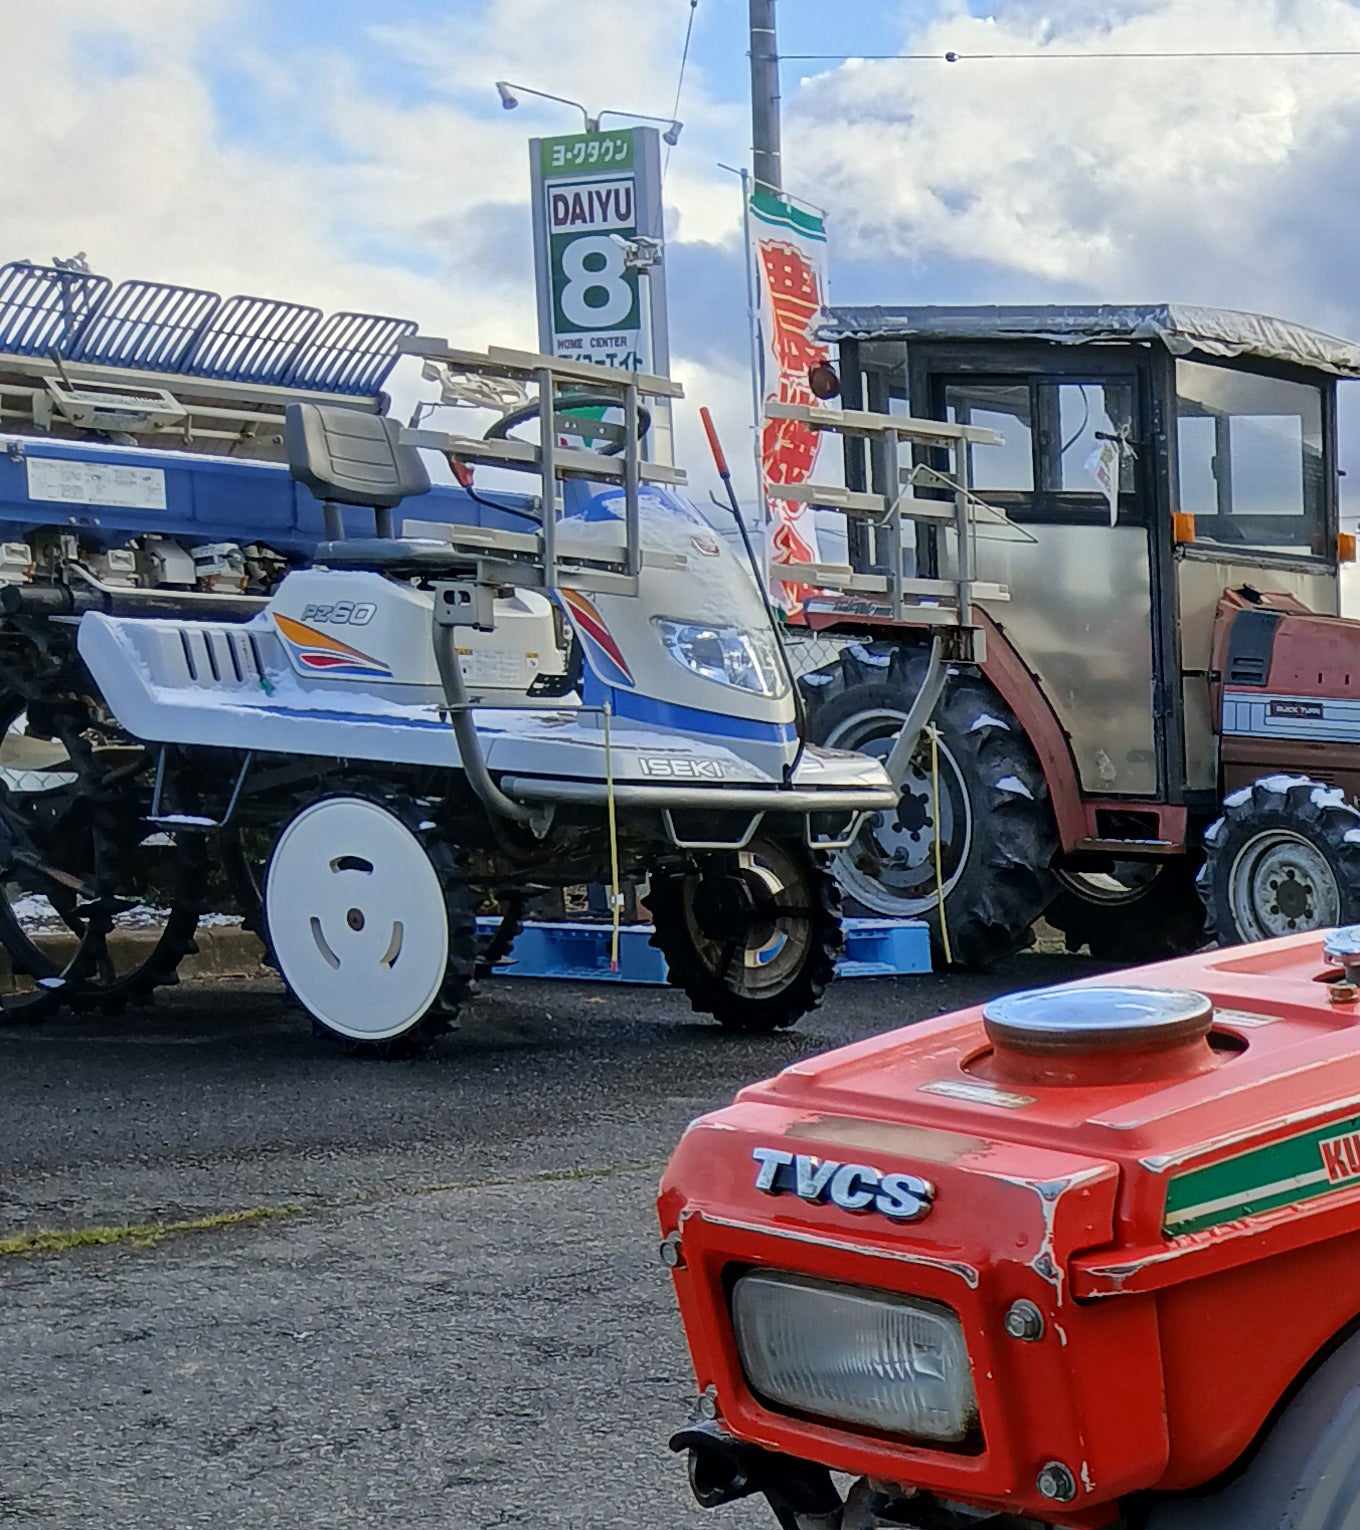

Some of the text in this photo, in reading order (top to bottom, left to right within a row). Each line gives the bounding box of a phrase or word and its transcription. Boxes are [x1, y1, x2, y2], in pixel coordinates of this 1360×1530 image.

[552, 187, 632, 226] DAIYU
[560, 235, 633, 328] 8
[557, 336, 628, 350] HOME CENTER
[301, 601, 377, 626] PZ60
[638, 757, 725, 779] ISEKI
[752, 1146, 935, 1221] TVCS
